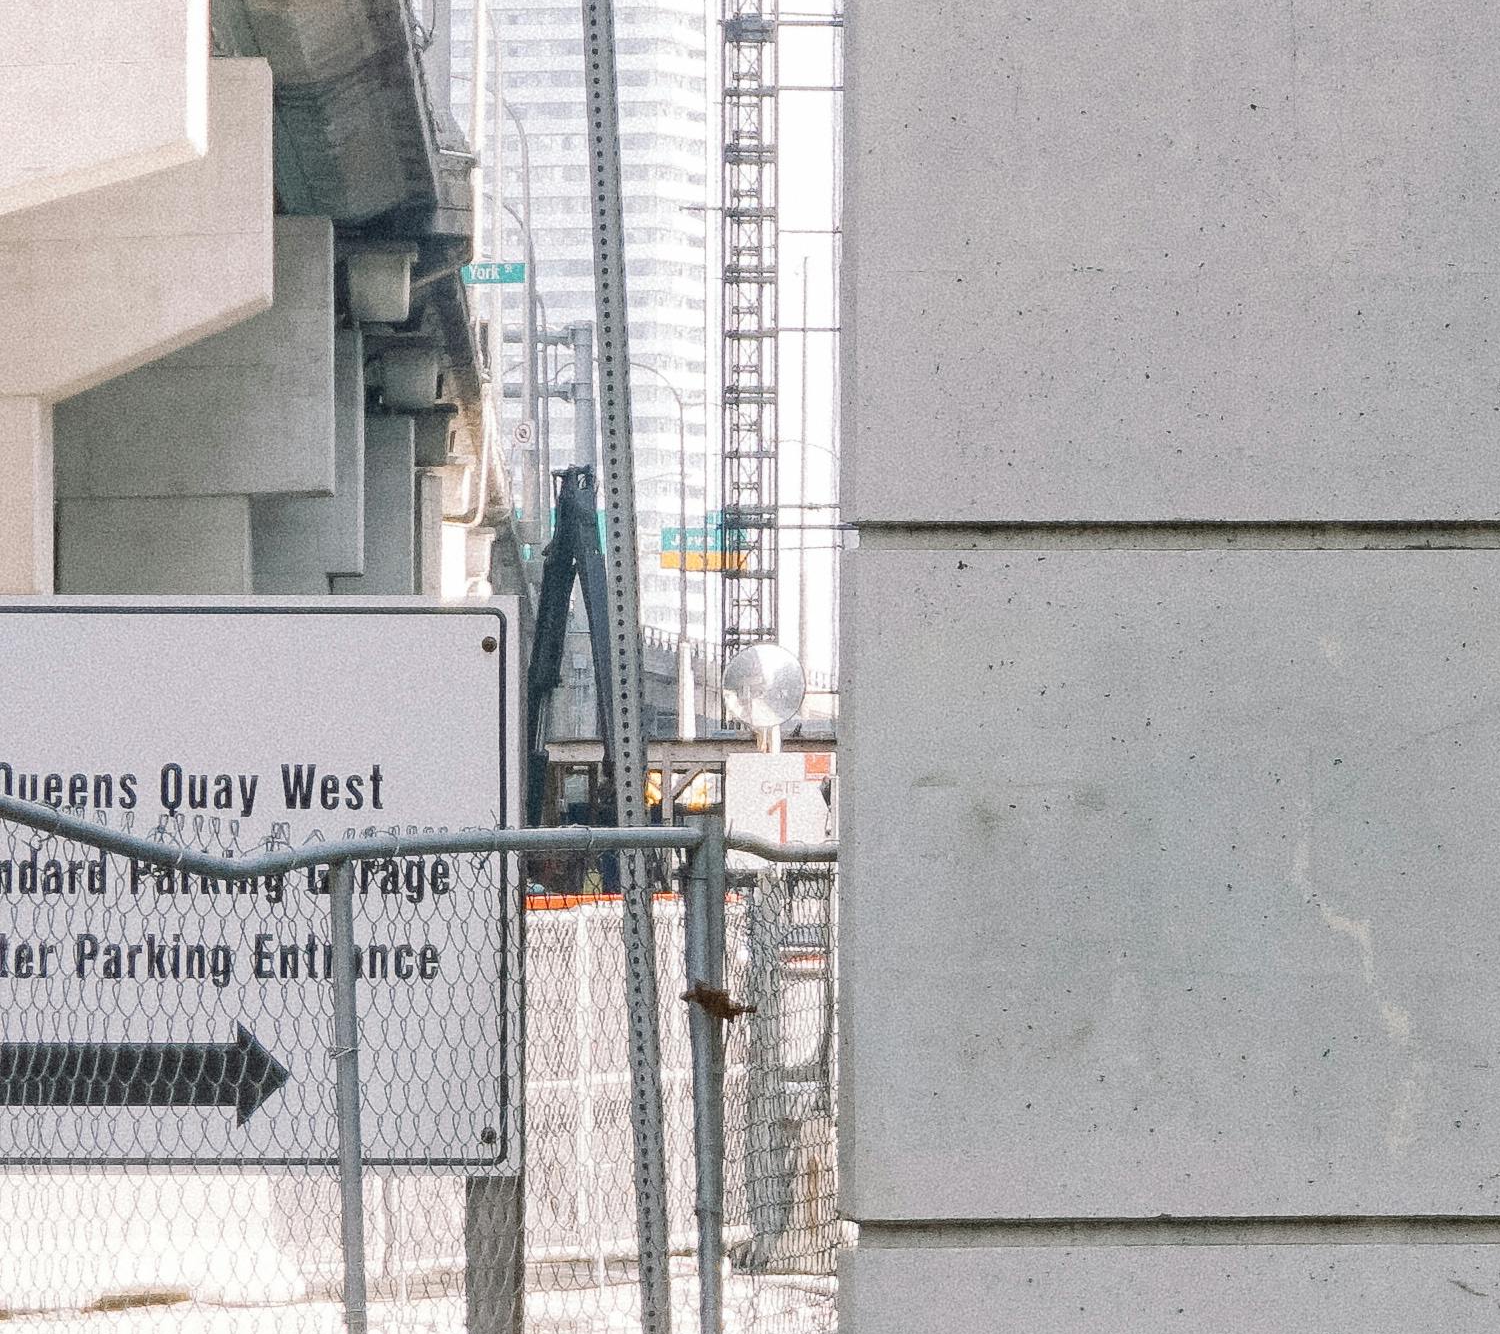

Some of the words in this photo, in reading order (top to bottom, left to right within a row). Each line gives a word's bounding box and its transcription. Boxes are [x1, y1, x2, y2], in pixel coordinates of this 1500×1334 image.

[469, 264, 500, 280] York
[160, 763, 258, 818] Quay
[281, 763, 384, 810] West
[761, 780, 801, 795] GATE
[767, 798, 788, 844] 1
[307, 858, 449, 904] Grage
[76, 933, 231, 987] Parking
